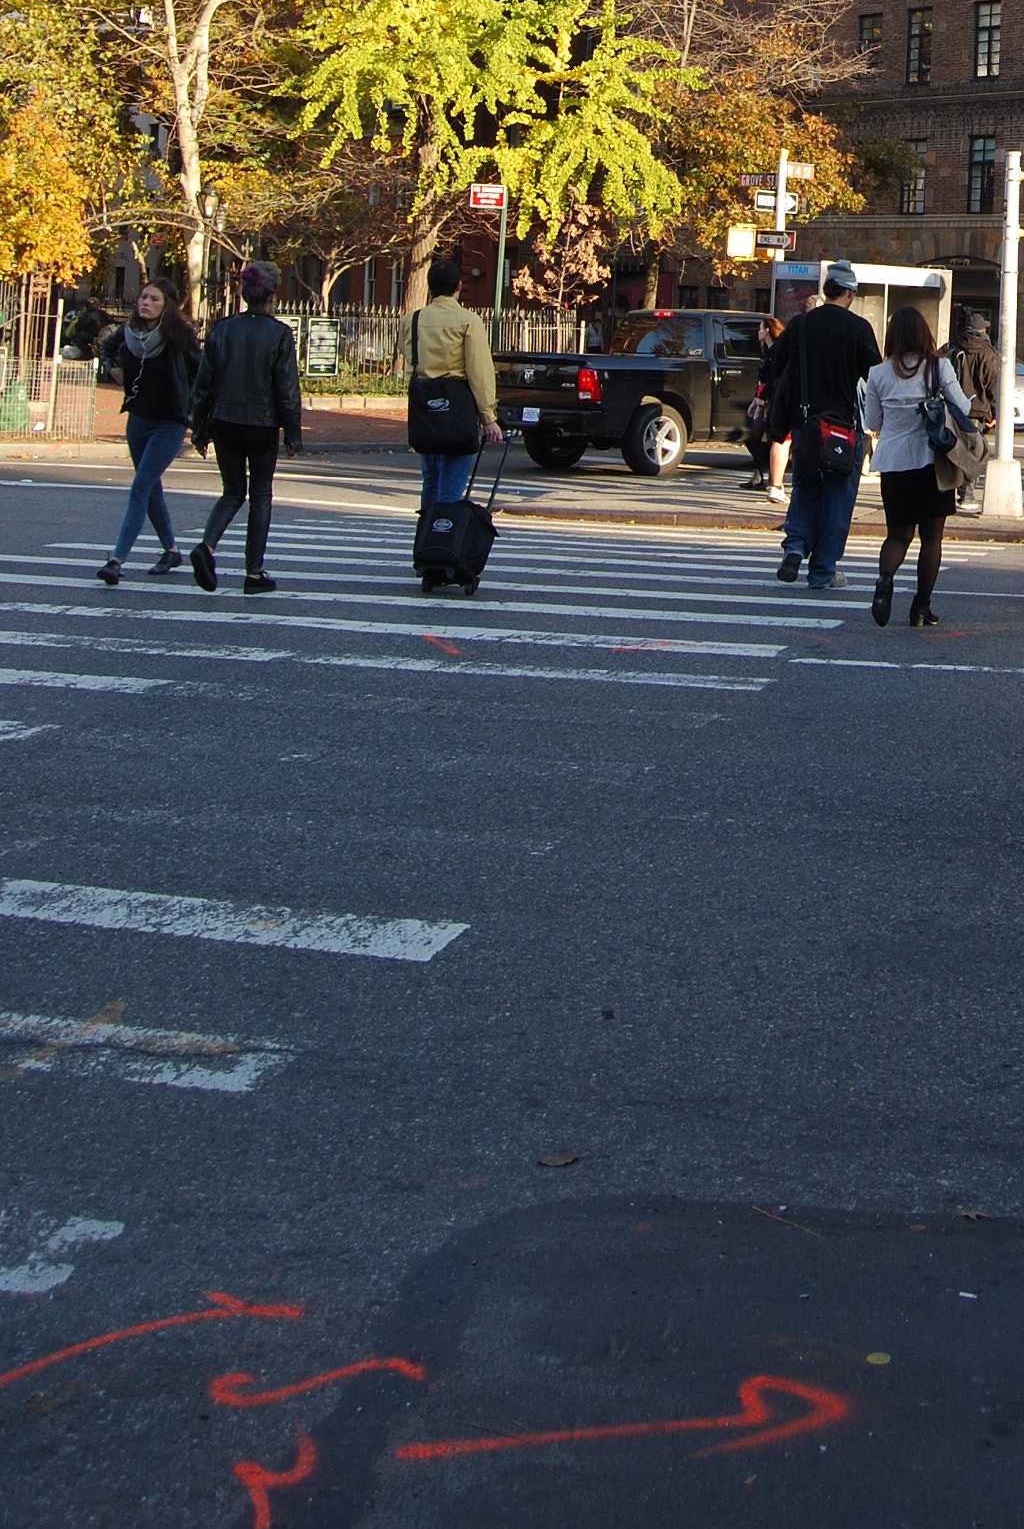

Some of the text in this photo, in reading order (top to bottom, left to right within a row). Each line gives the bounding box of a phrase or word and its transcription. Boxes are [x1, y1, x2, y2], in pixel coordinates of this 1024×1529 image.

[803, 167, 812, 179] ST
[741, 174, 775, 186] GROVE ST
[760, 235, 789, 244] ONE WAY
[787, 265, 809, 275] TITAN
